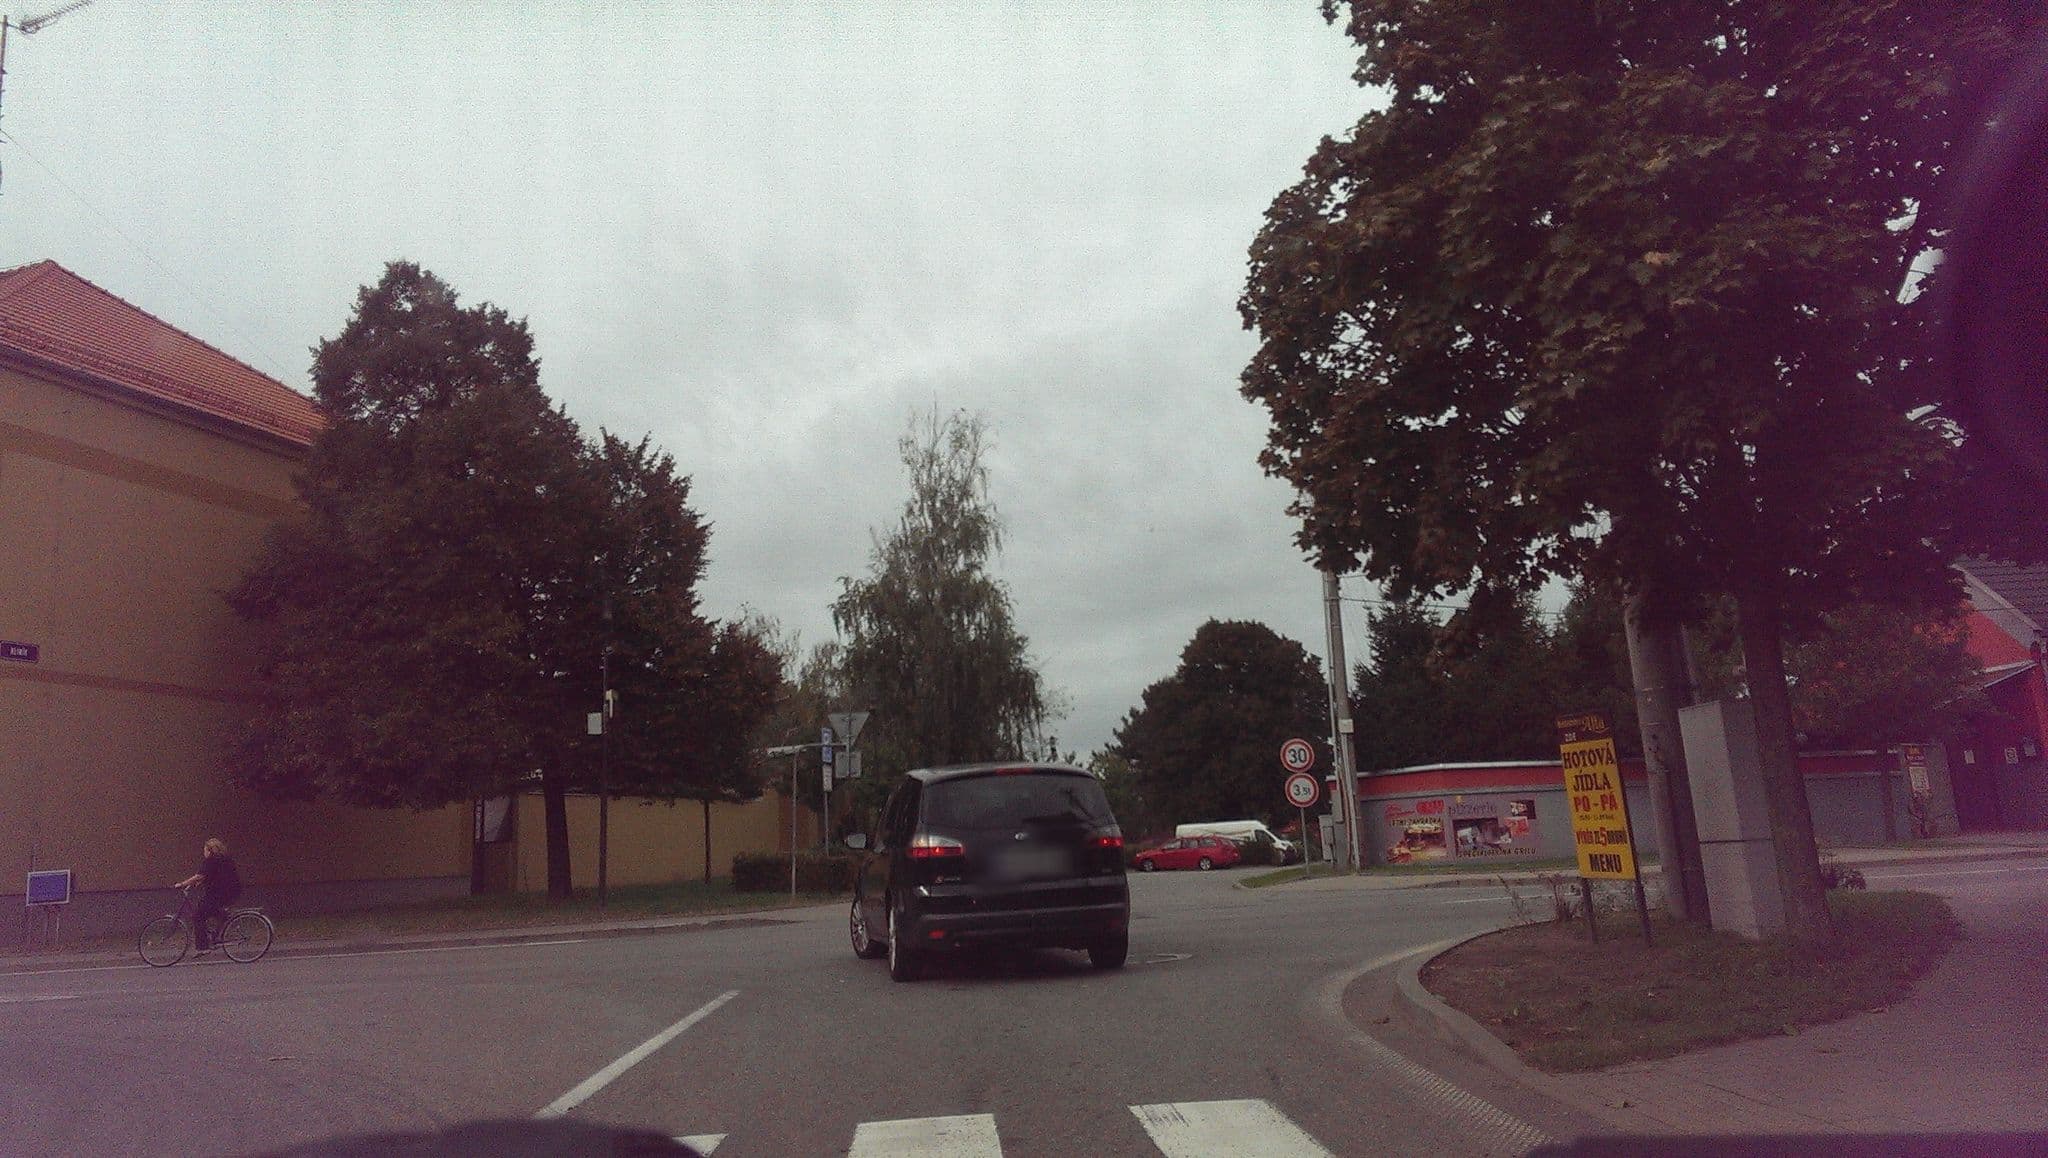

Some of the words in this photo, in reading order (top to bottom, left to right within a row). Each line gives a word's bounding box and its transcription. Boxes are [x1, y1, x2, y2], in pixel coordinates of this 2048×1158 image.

[1288, 748, 1307, 764] 30
[1563, 743, 1616, 769] HOTOVÁ
[1573, 769, 1612, 792] JÍDLA
[1574, 796, 1591, 812] PO
[1600, 791, 1618, 811] PÁ
[1600, 826, 1607, 847] 5
[1589, 853, 1622, 873] MENU
